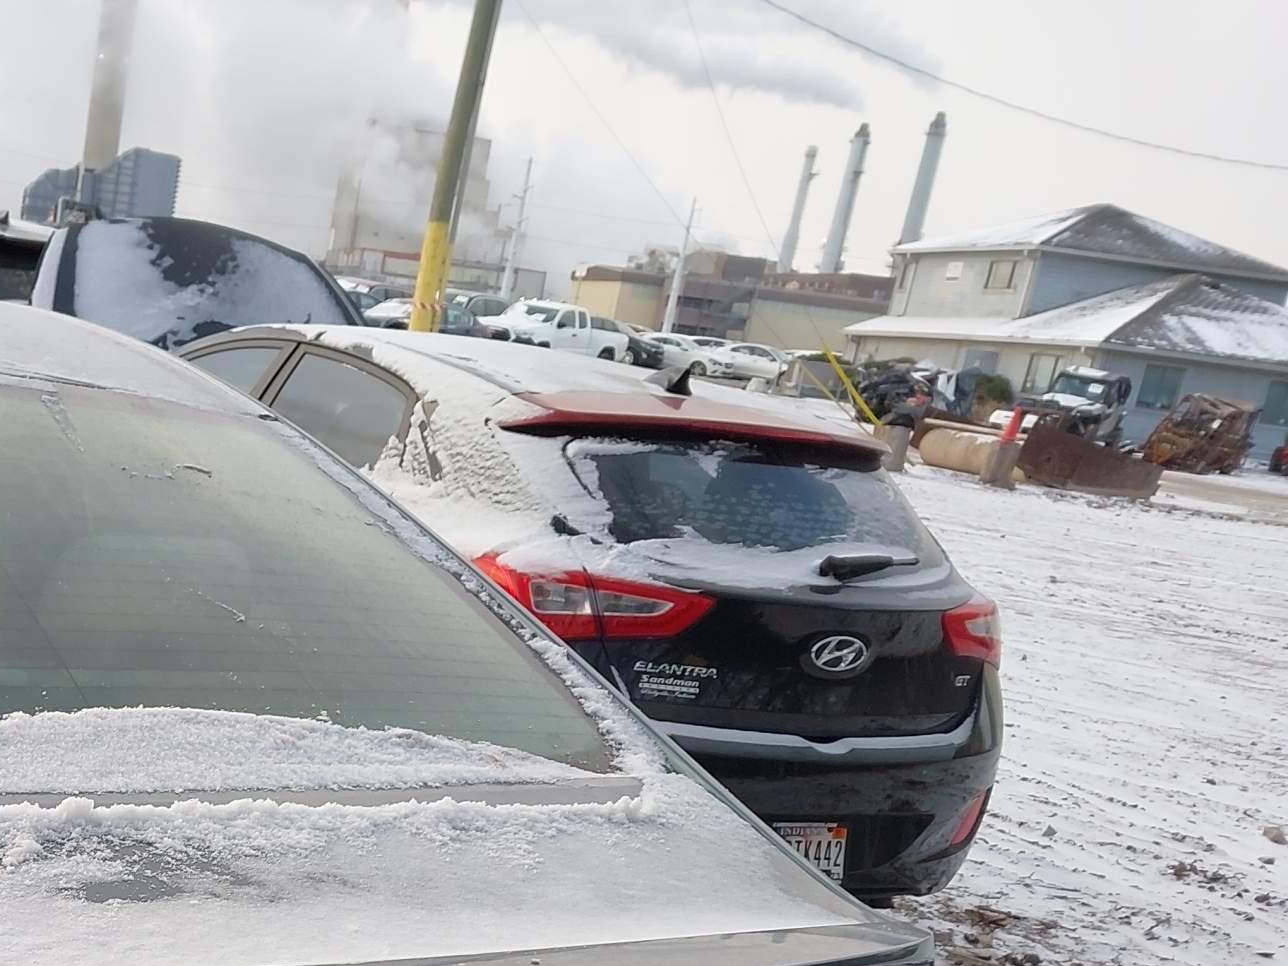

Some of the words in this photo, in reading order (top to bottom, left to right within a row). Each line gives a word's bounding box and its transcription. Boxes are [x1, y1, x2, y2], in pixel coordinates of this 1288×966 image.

[633, 660, 718, 679] ELANTRA
[640, 674, 699, 688] Sandman
[955, 675, 971, 686] GT
[786, 840, 842, 868] TK442
